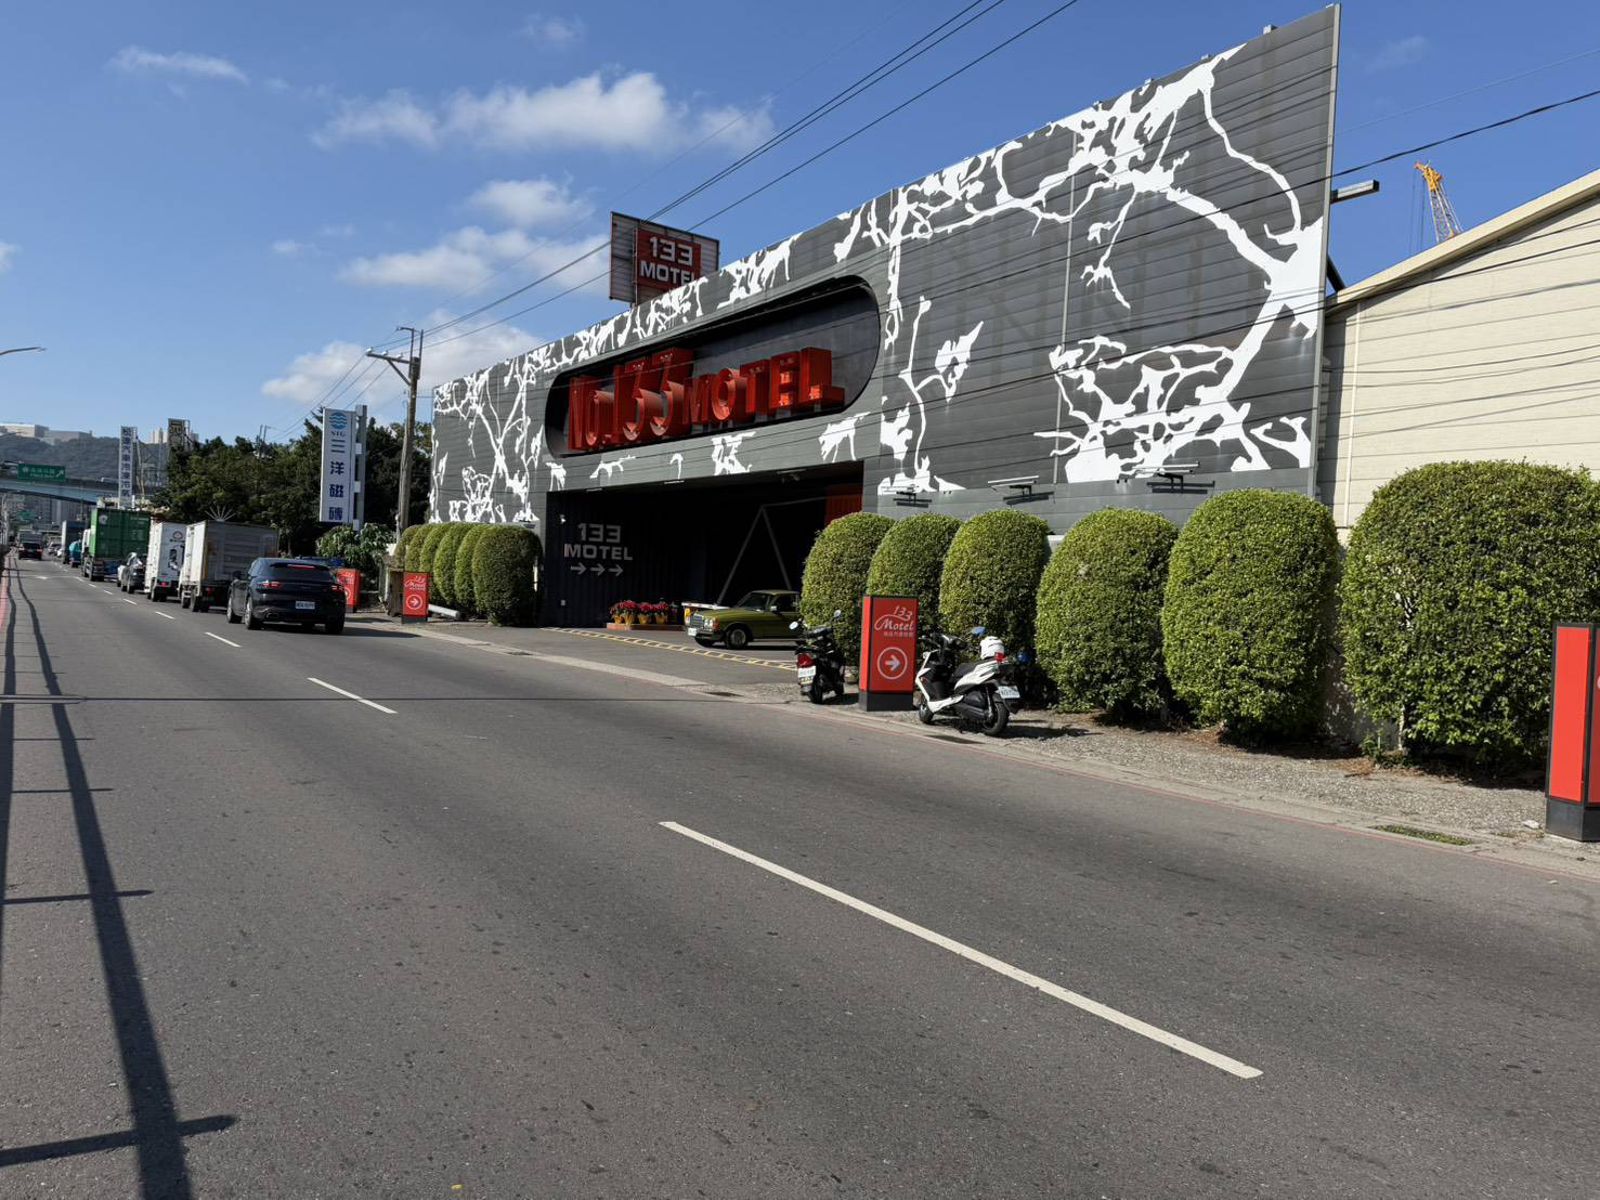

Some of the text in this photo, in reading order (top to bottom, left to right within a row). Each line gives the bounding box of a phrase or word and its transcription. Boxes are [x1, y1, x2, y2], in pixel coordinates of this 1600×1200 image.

[649, 236, 693, 266] 133
[682, 347, 845, 425] MOTEL
[578, 522, 621, 543] 133
[563, 543, 633, 560] MOTEL
[893, 605, 913, 621] 133
[874, 615, 914, 631] Motel
